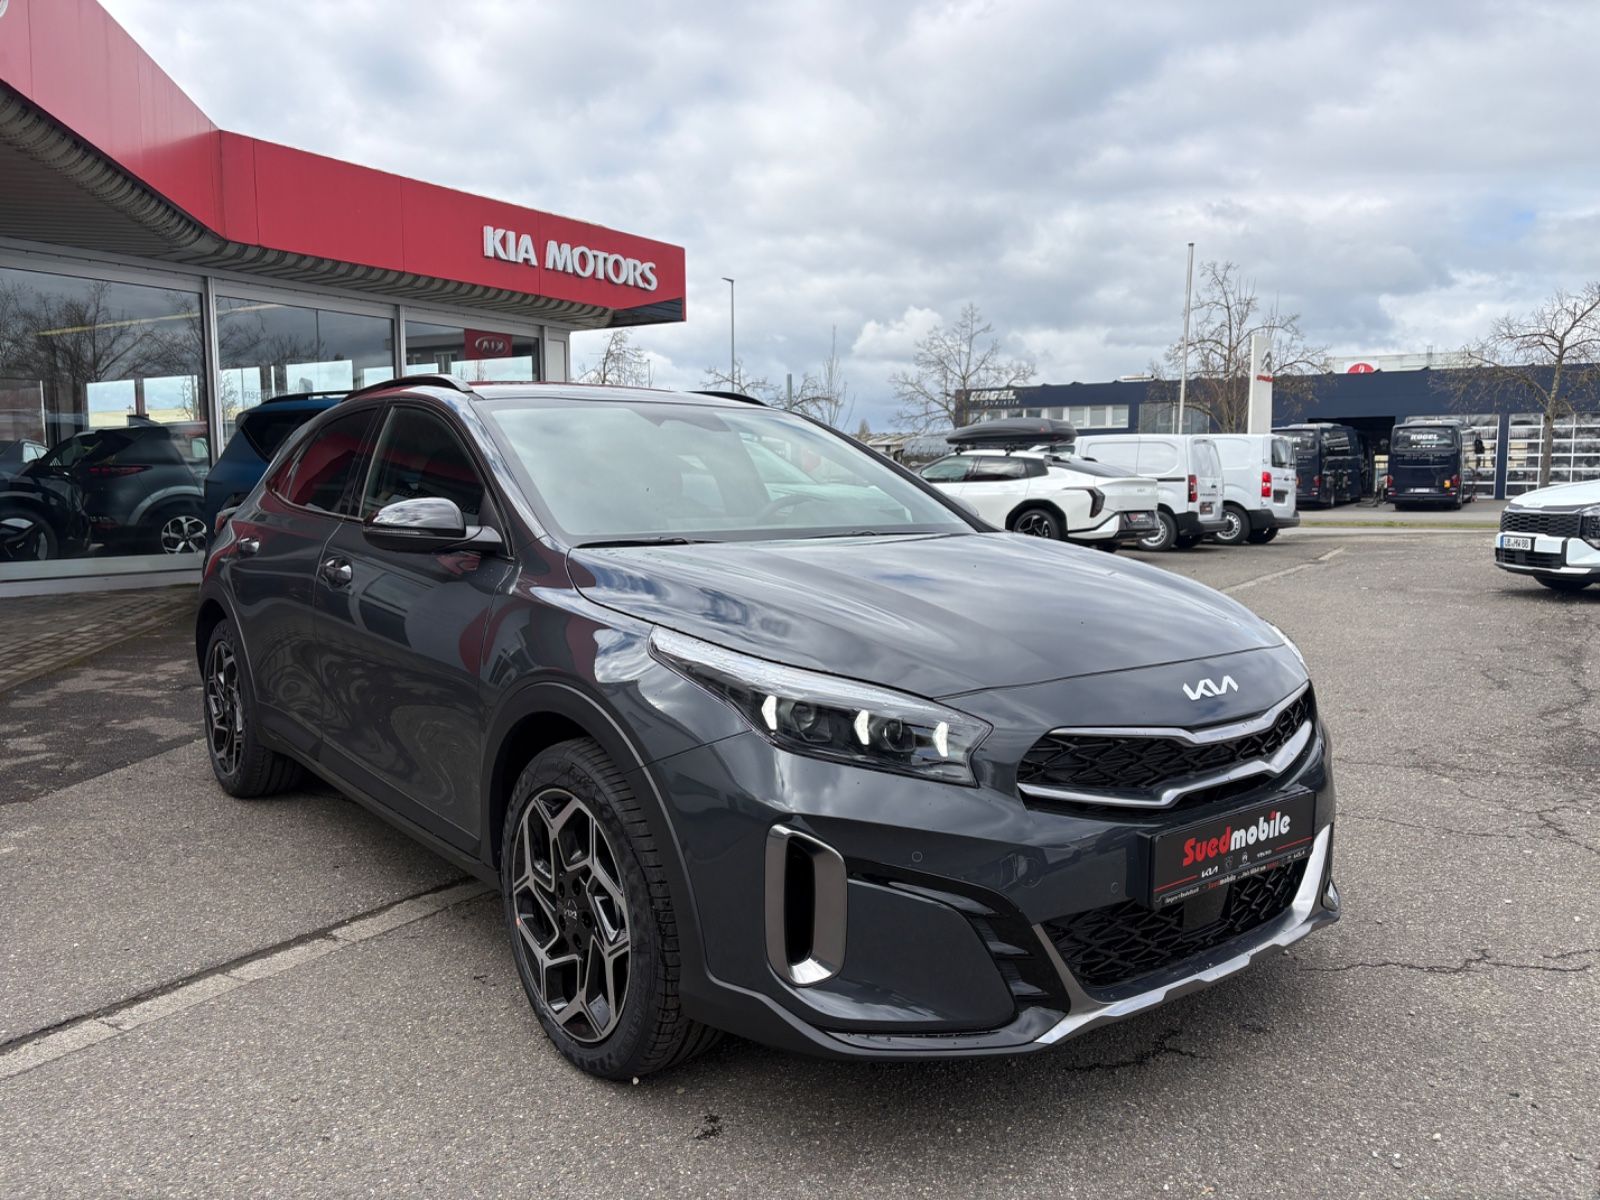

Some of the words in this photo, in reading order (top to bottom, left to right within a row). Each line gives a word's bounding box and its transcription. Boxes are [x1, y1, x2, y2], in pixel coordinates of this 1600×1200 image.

[483, 225, 538, 267] KIA
[545, 240, 658, 291] MOTORS
[1182, 675, 1239, 701] KIA
[1182, 810, 1291, 867] Suedmobile
